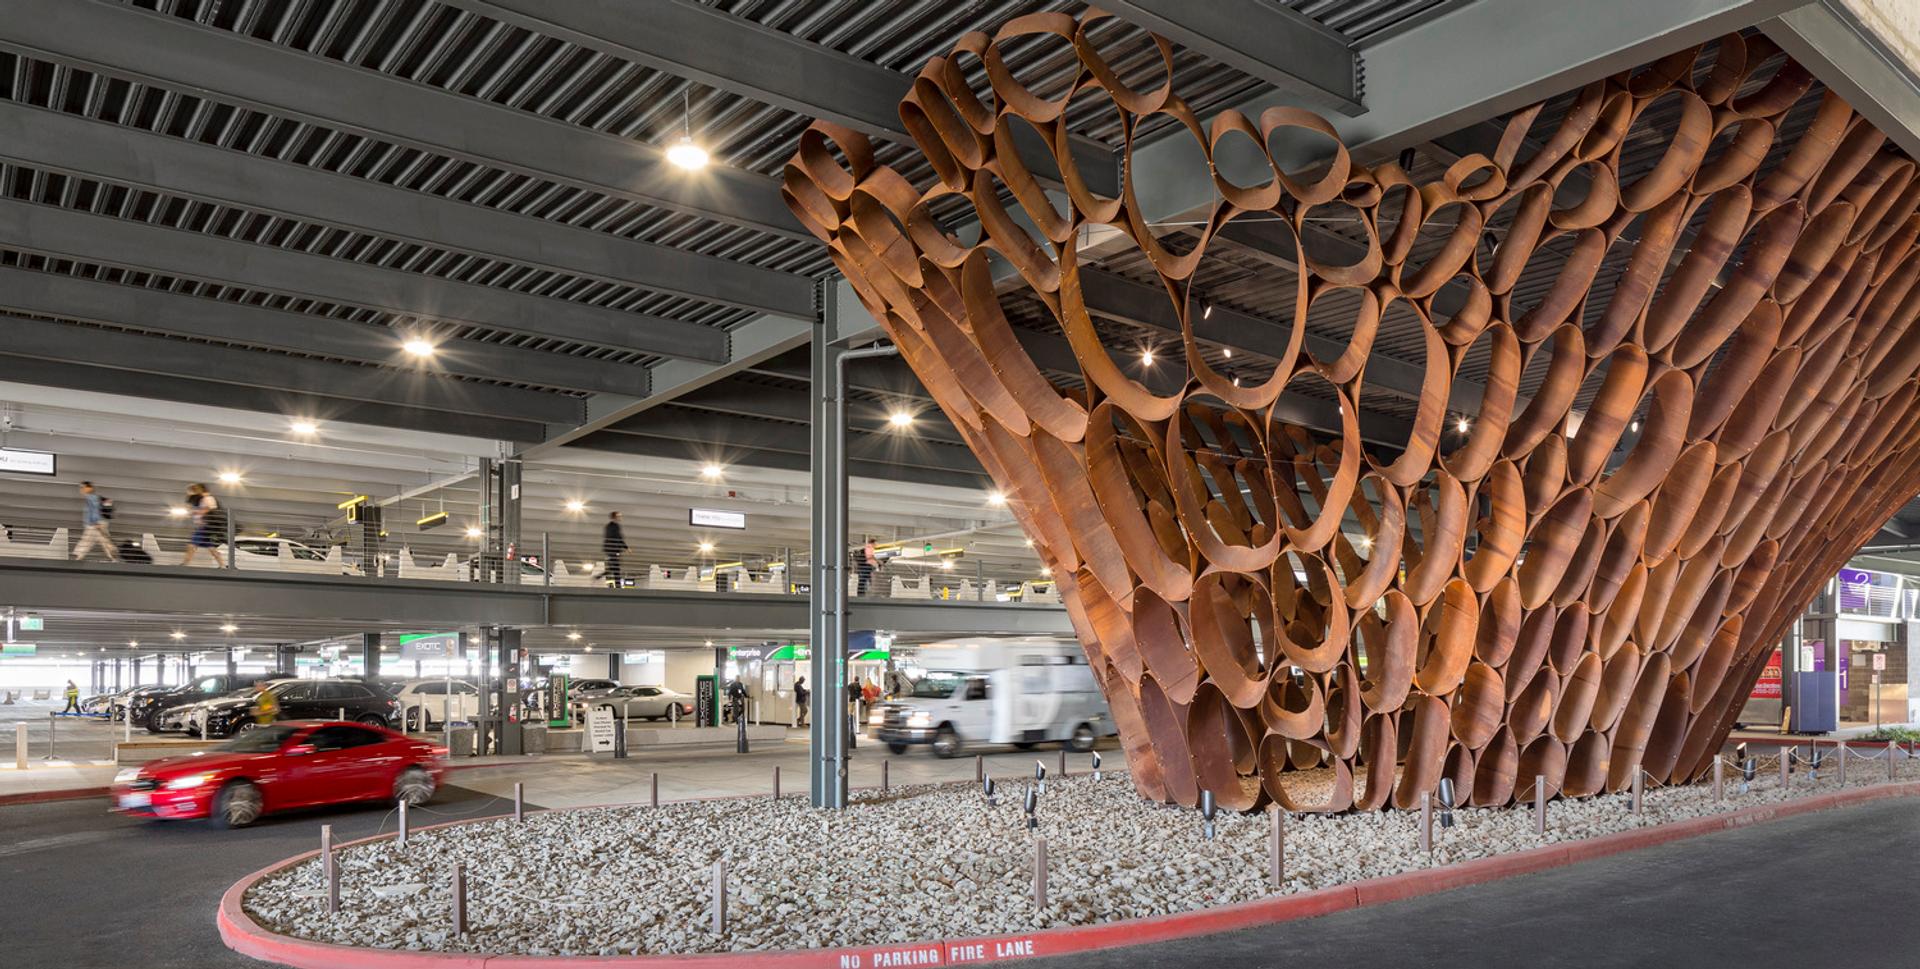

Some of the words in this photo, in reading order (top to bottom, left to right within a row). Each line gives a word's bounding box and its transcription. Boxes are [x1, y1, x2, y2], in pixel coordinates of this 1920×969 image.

[840, 954, 861, 969] NO
[873, 949, 939, 967] PARKING
[951, 944, 985, 961] FIRE
[996, 940, 1034, 958] LANE
